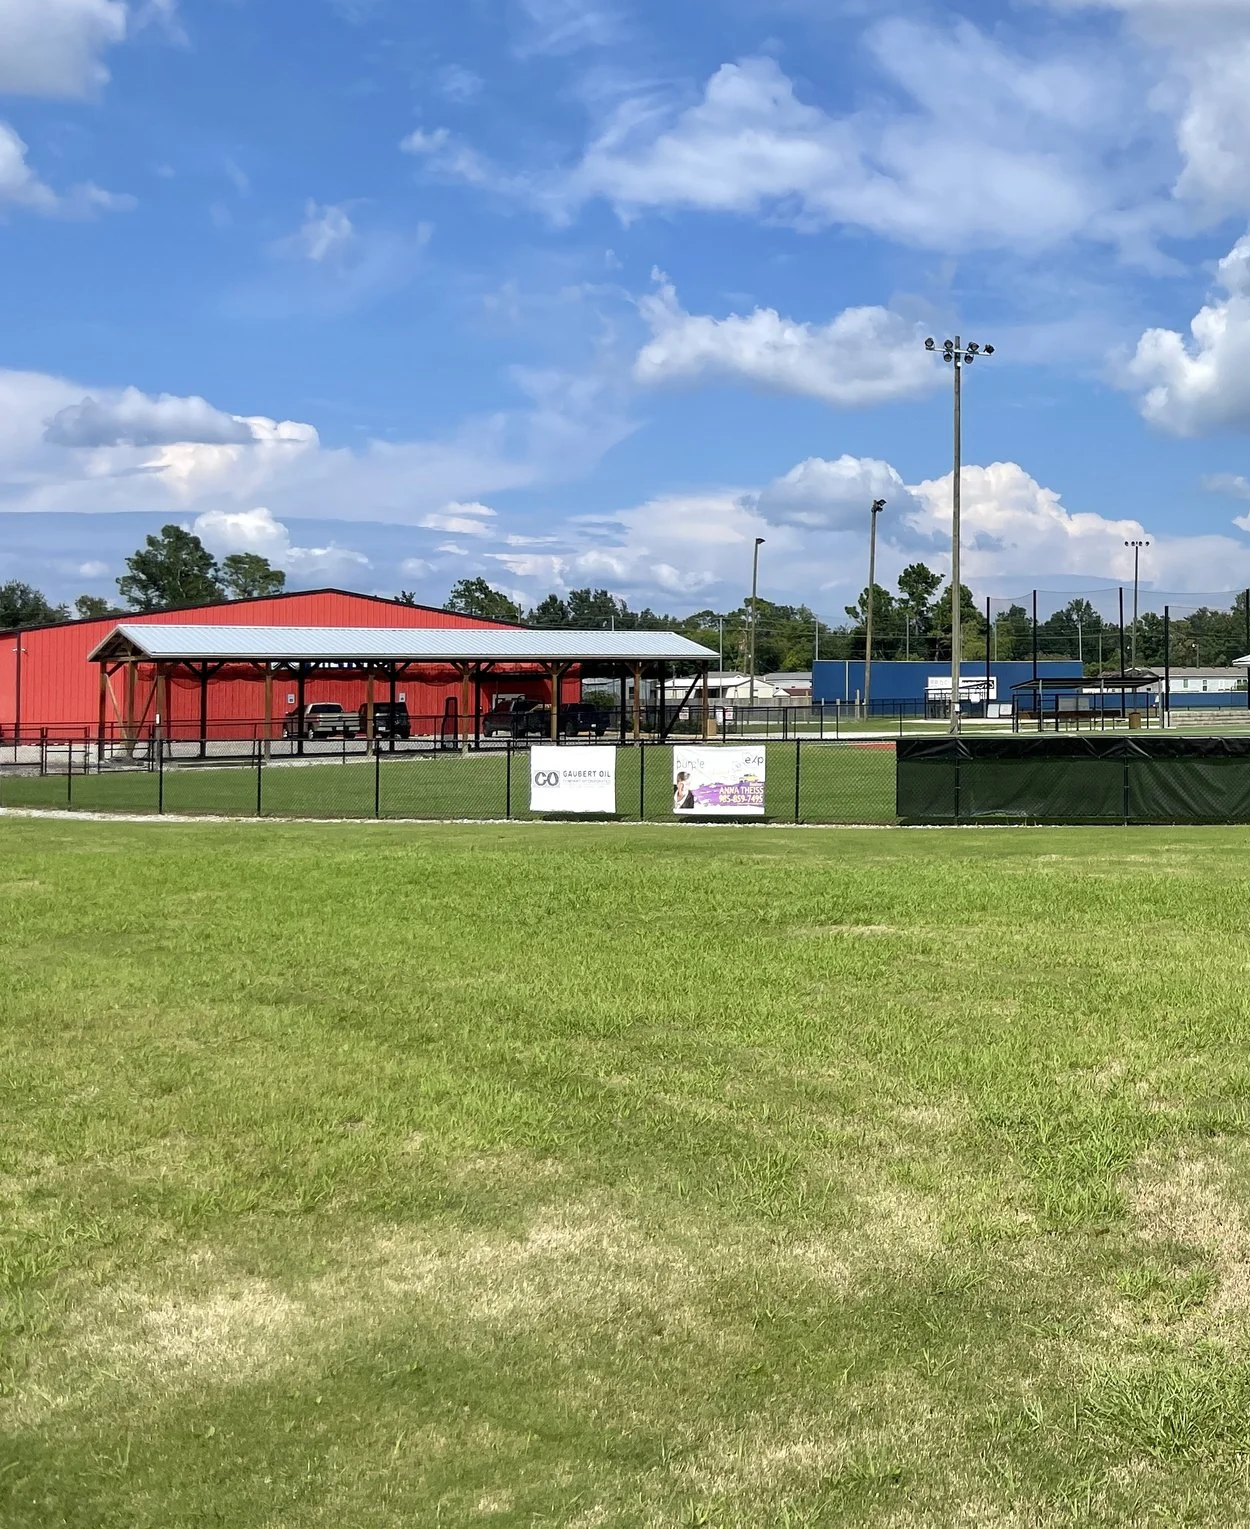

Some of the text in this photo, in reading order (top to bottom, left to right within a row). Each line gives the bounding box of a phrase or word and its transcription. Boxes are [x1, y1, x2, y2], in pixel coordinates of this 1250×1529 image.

[562, 770, 611, 778] GAUBERT OIL
[719, 786, 764, 794] ANNA THEISS
